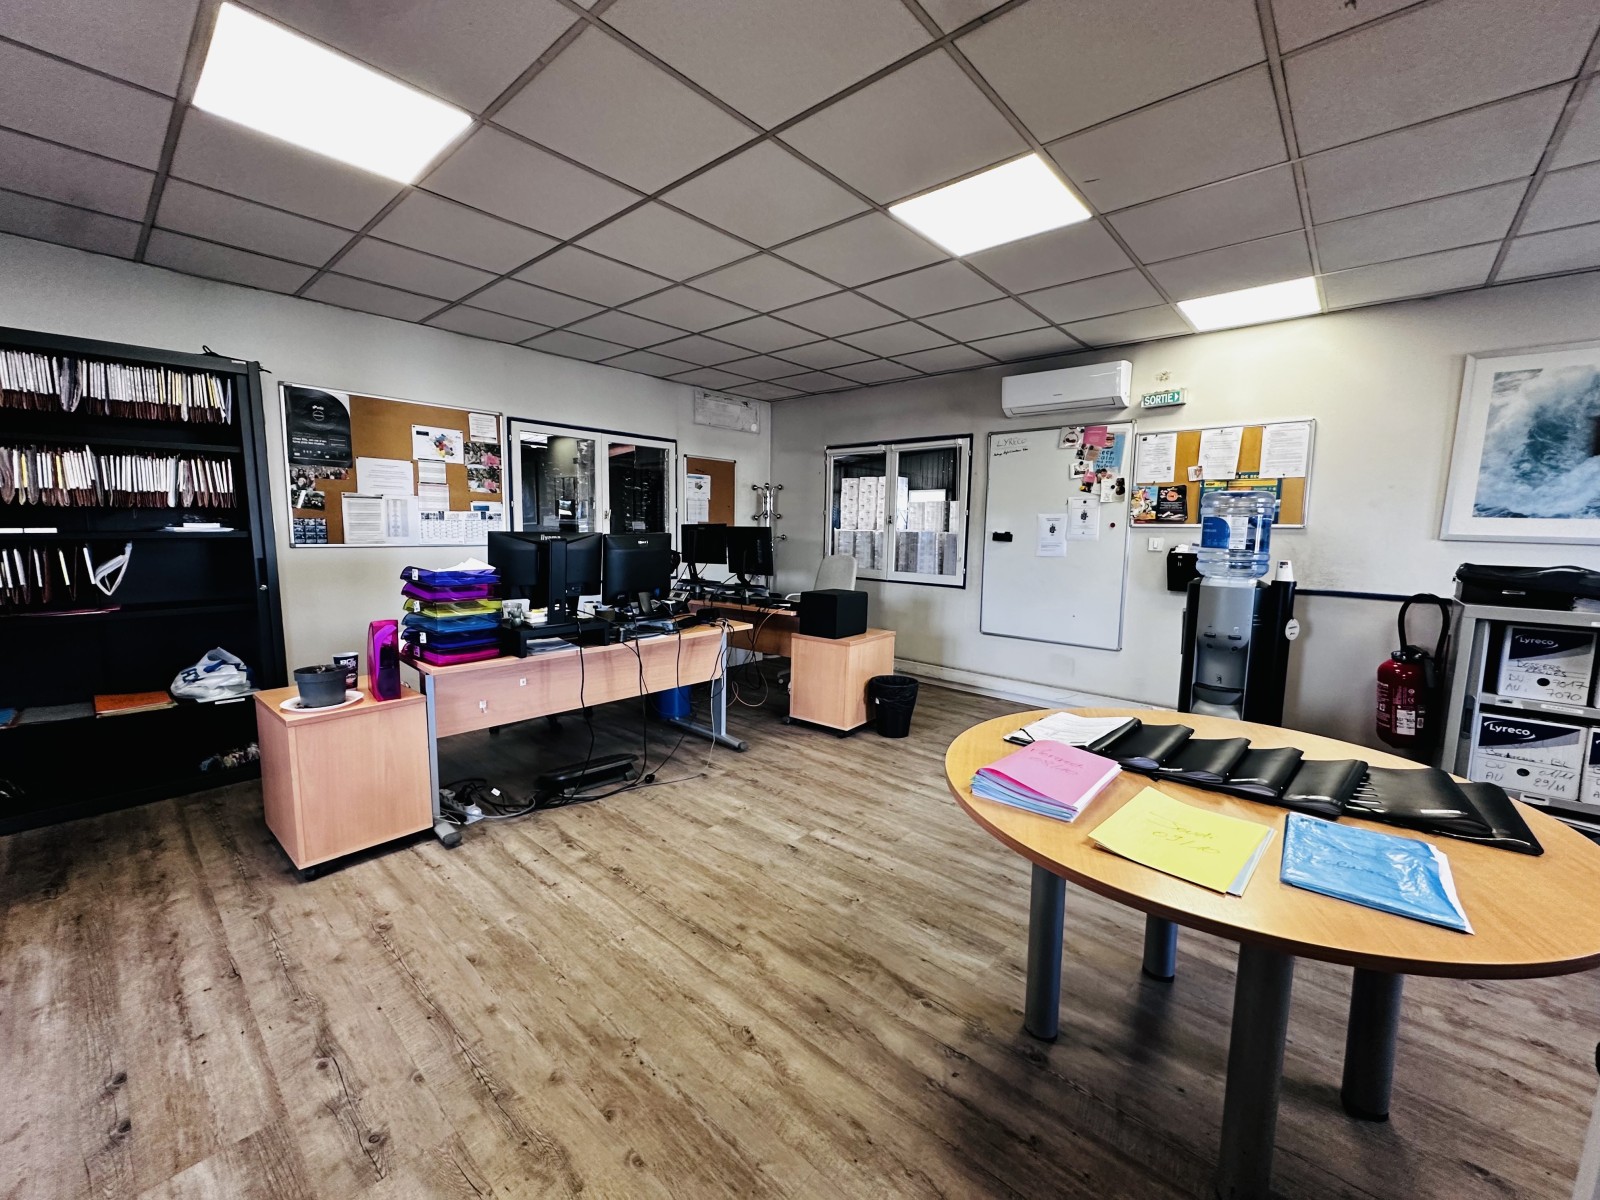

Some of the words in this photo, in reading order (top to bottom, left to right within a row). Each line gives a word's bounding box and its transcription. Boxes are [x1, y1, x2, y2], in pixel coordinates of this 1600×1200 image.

[1144, 392, 1174, 406] SORTIE
[1519, 637, 1554, 646] Lyreco
[1545, 689, 1582, 701] 7070
[1489, 723, 1531, 736] Lyreco
[1485, 761, 1507, 769] DU
[1485, 771, 1504, 782] AU
